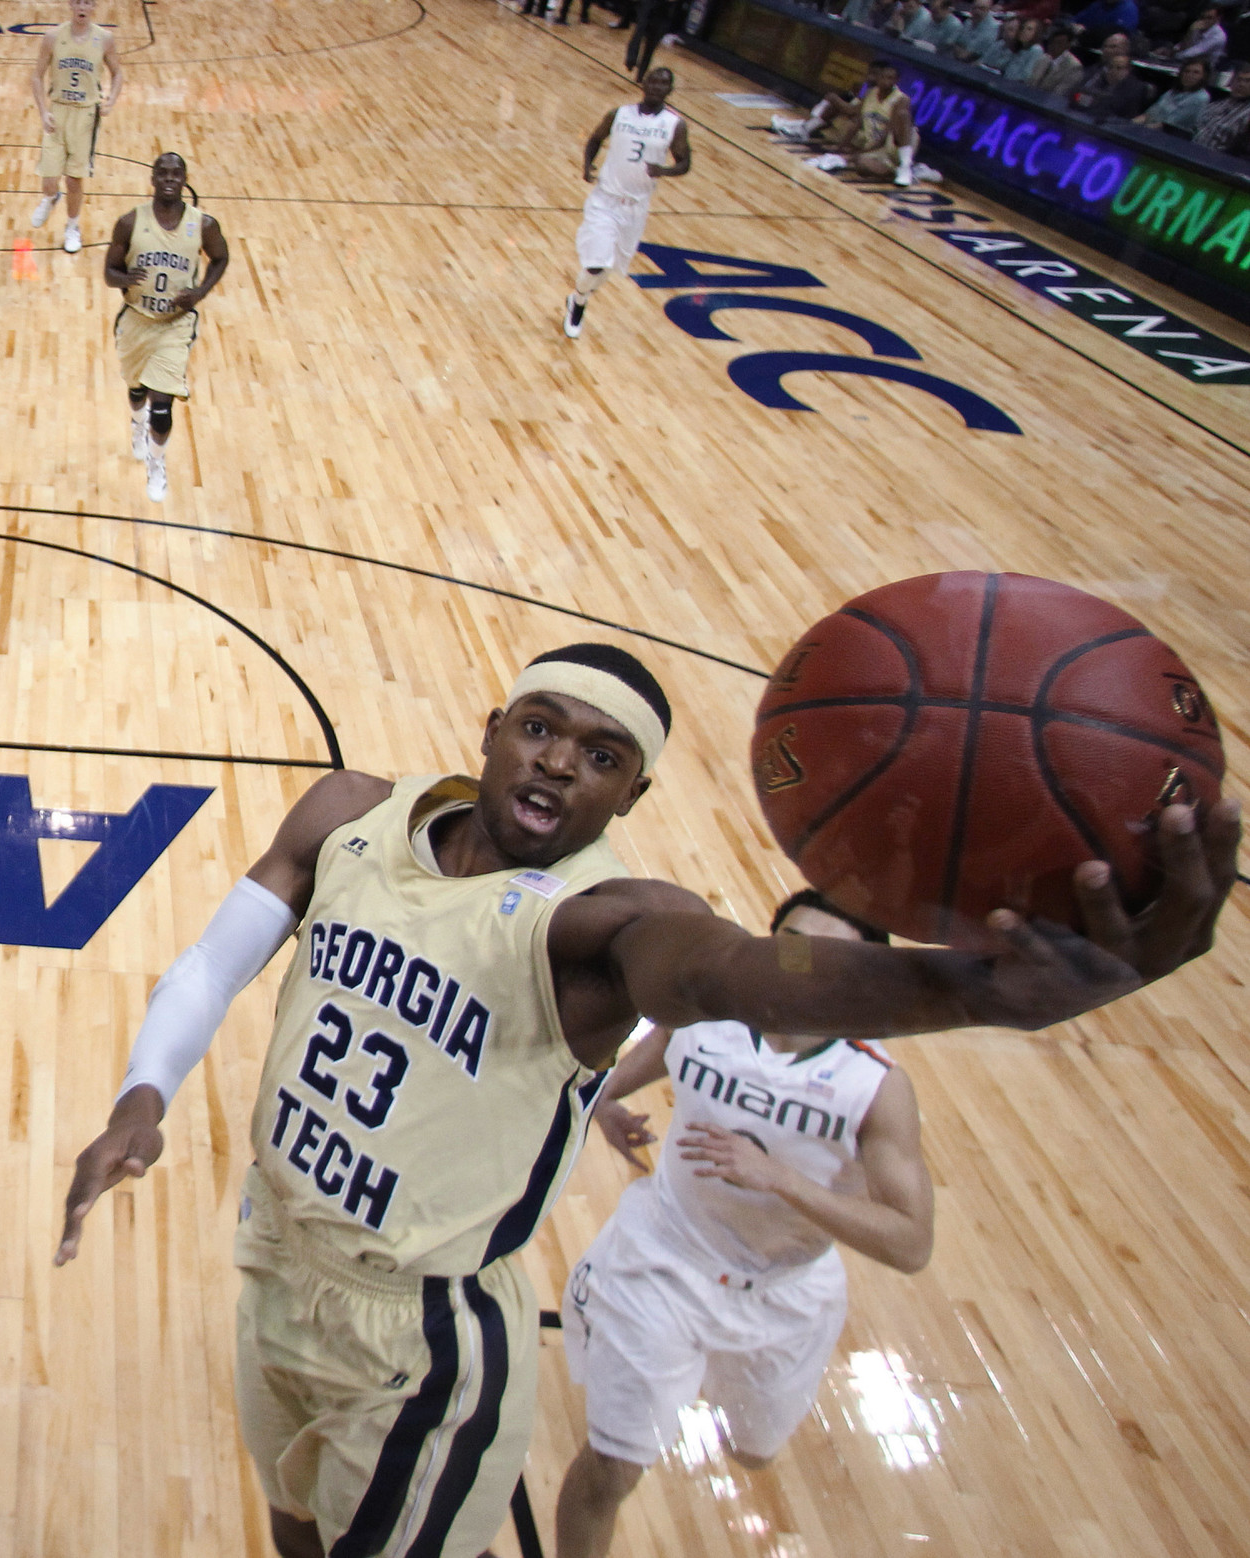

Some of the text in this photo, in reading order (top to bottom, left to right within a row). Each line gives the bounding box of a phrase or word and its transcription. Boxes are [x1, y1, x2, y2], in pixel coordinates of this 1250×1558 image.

[58, 57, 96, 73] GEORGIA
[61, 89, 87, 102] TECH
[69, 72, 80, 88] 5
[627, 140, 645, 162] 3
[910, 79, 975, 142] 2012
[971, 112, 1062, 177] ACC
[1056, 142, 1250, 269] TOURNA
[136, 251, 190, 273] GEORGIA
[154, 272, 168, 293] 0
[627, 241, 1024, 436] ACC
[949, 234, 1250, 377] ARENA
[309, 921, 492, 1083] GEORGIA
[298, 1000, 410, 1131] 23
[270, 1086, 400, 1233] TECH
